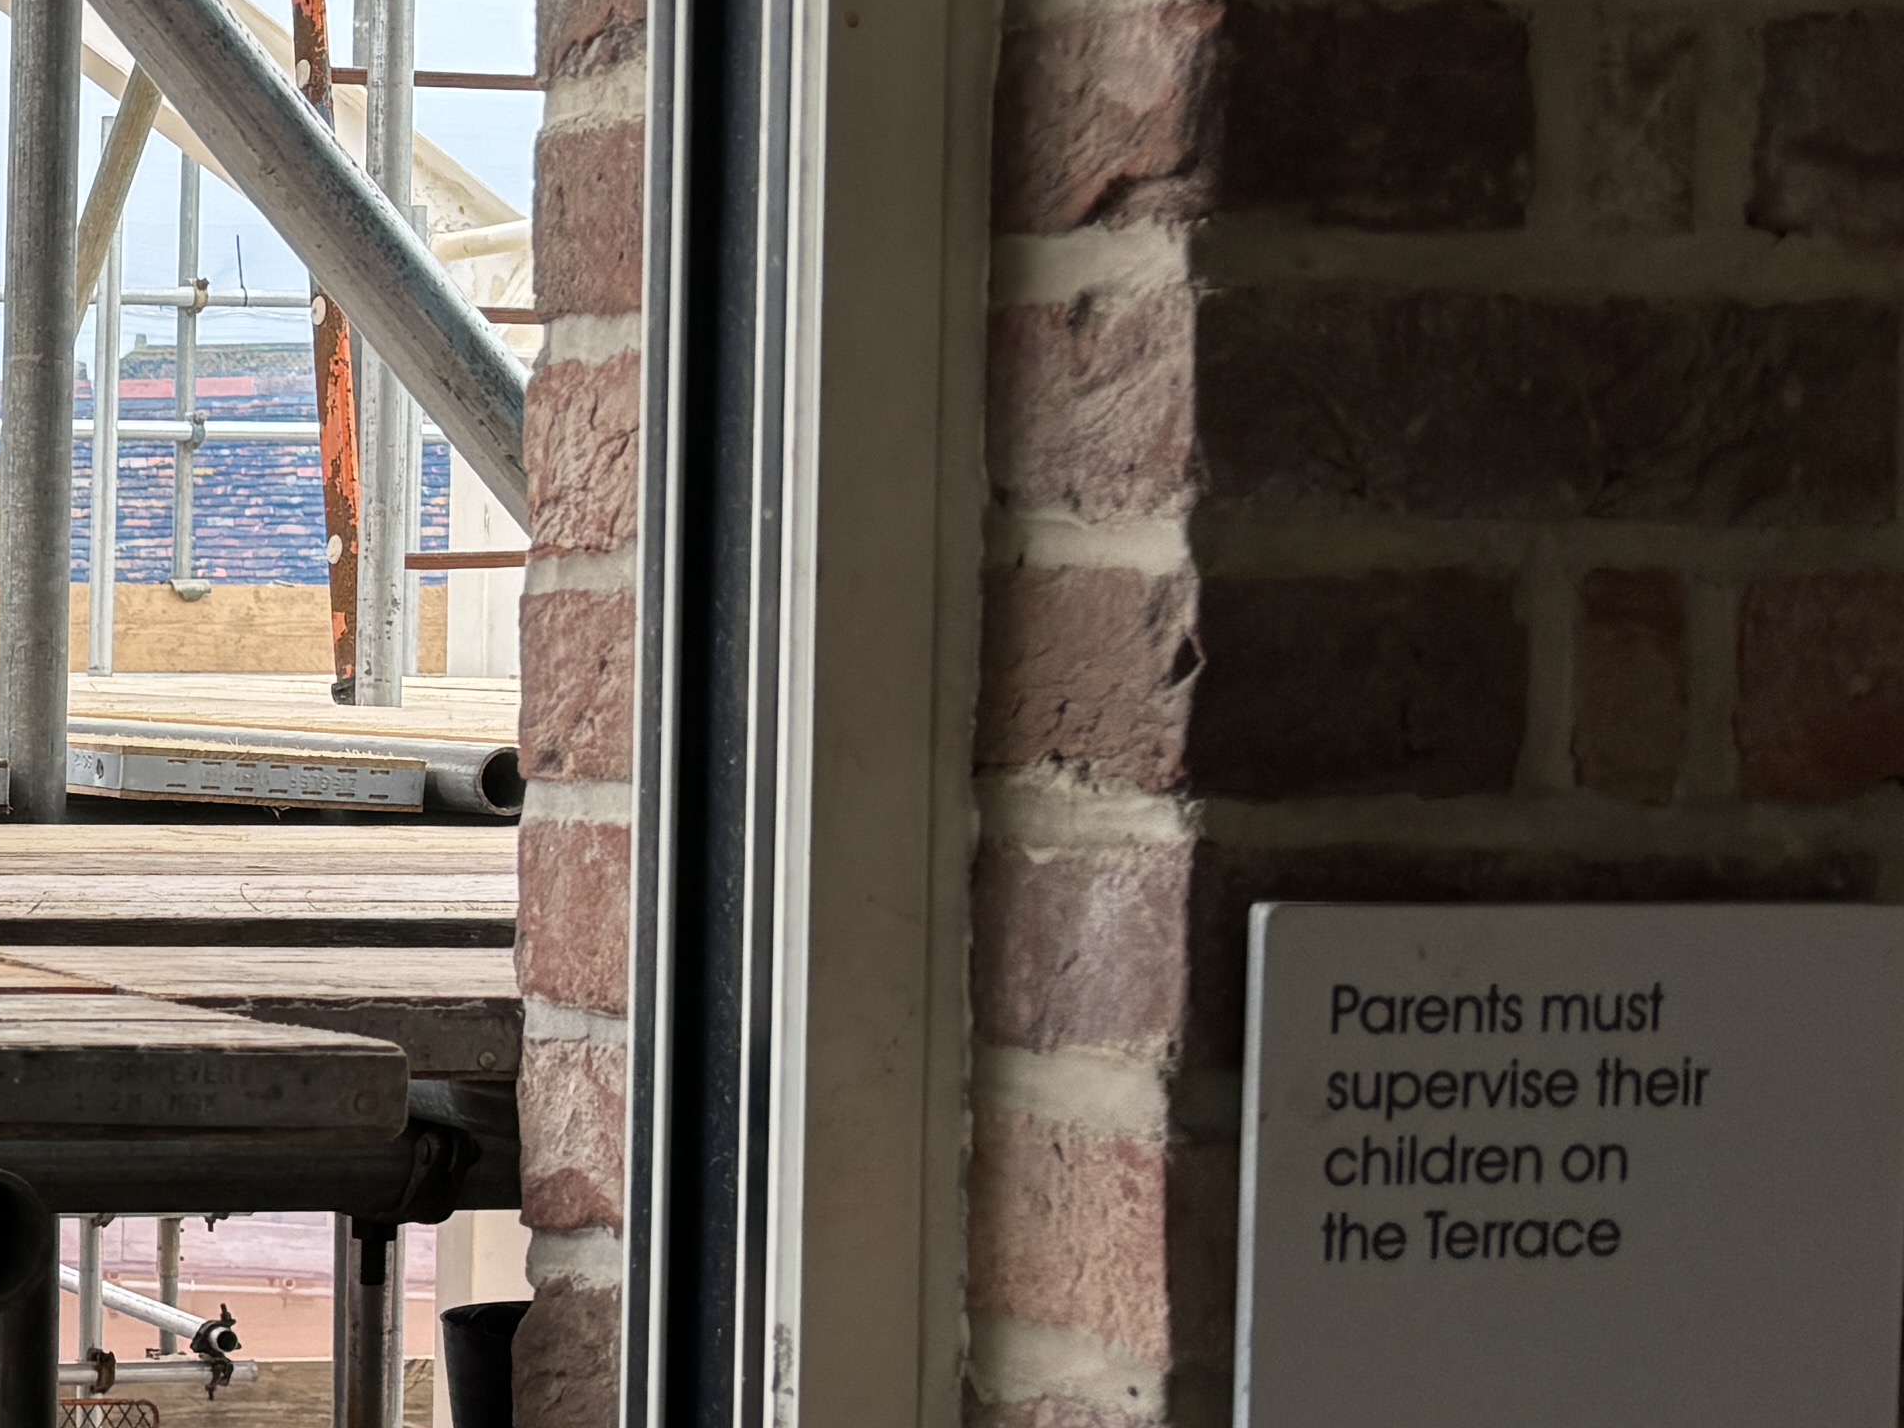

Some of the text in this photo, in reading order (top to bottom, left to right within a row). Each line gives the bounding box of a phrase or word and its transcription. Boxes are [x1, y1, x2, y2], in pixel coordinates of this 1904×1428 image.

[1331, 982, 1664, 1035] Parents must
[43, 1060, 253, 1086] SUPPORT EVERY
[1326, 1057, 1709, 1121] supervise their
[1324, 1135, 1628, 1187] children on
[1322, 1210, 1621, 1262] the Terrace
